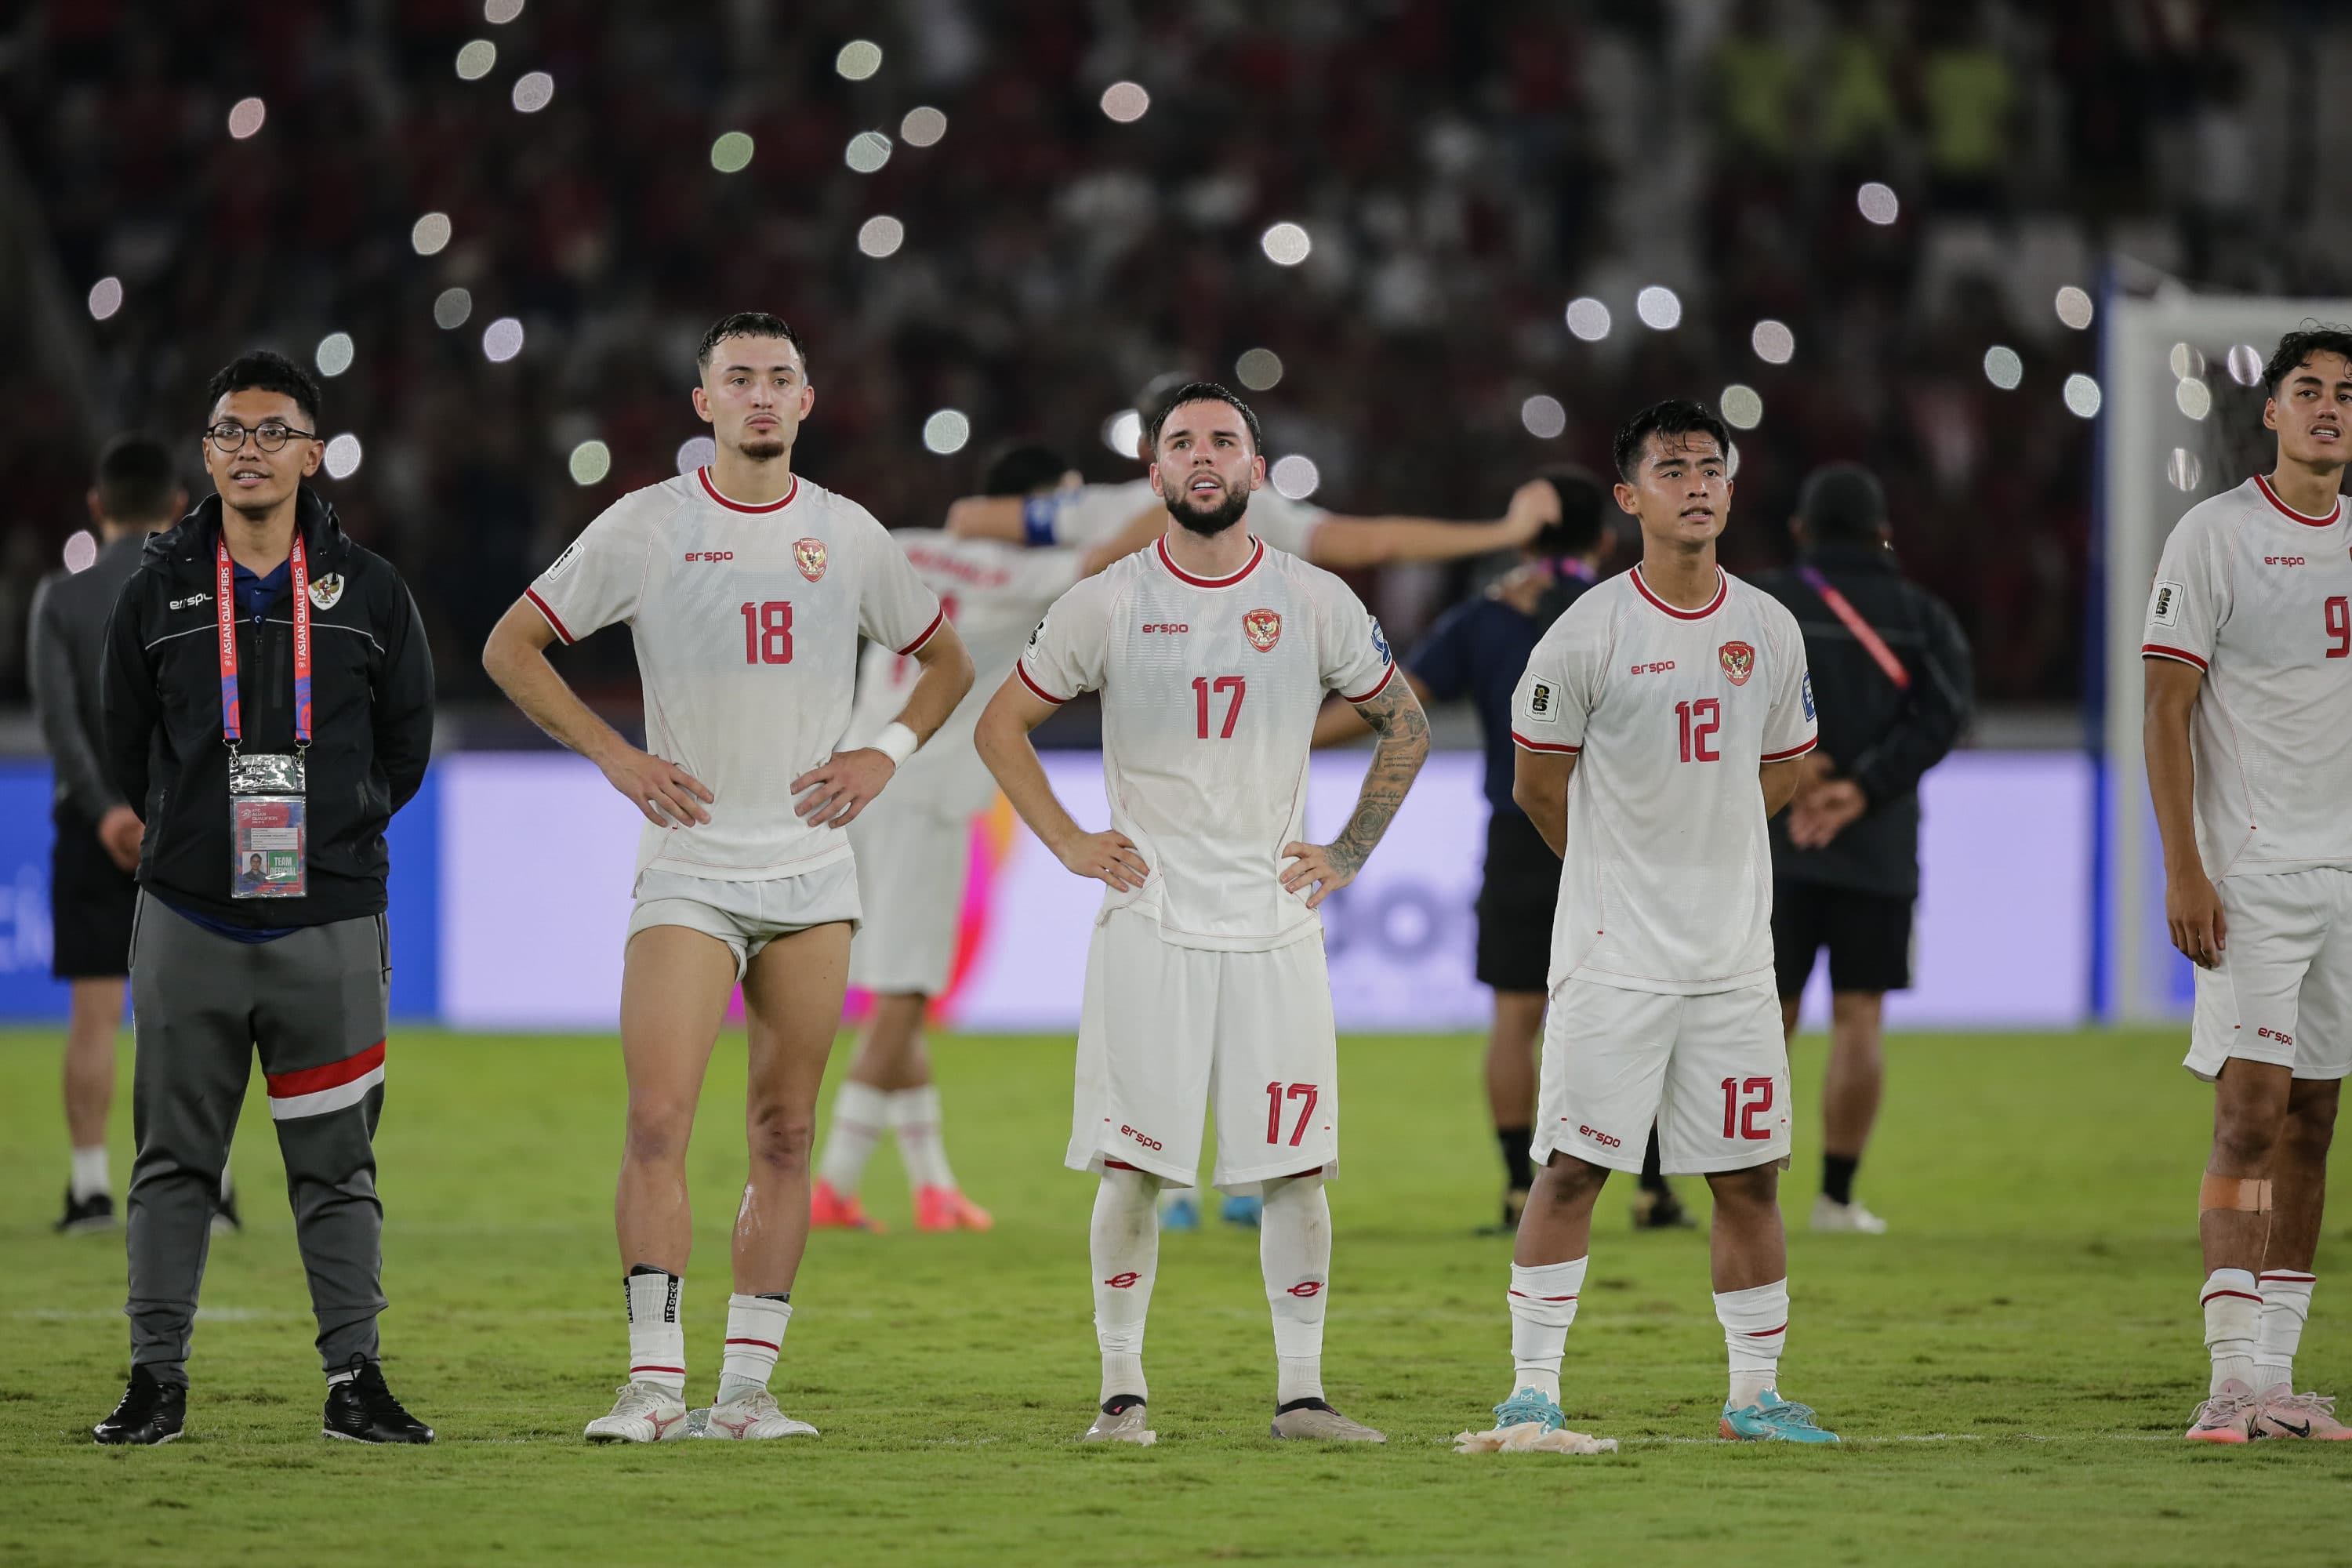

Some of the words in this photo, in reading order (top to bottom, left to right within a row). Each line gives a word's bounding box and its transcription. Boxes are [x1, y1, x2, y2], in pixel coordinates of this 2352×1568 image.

[685, 551, 734, 564] erspo
[2264, 556, 2306, 567] erspo
[220, 567, 230, 622] QUALIFIERS
[294, 567, 307, 623] QUALIFIERS
[223, 624, 233, 655] ASIAN
[297, 625, 307, 656] ASIAN
[741, 601, 793, 665] 18
[1142, 623, 1189, 635] erspo
[2325, 596, 2351, 659] 9
[1631, 660, 1675, 675] erspo
[1192, 675, 1246, 739] 17
[1675, 697, 1720, 763] 12
[270, 866, 297, 877] OFFICIAL
[274, 857, 292, 866] TEAM
[2258, 1027, 2293, 1046] erspo
[1266, 1081, 1318, 1147] 17
[1721, 1077, 1773, 1140] 12
[1120, 1124, 1163, 1152] erspo
[1579, 1124, 1621, 1149] erspo
